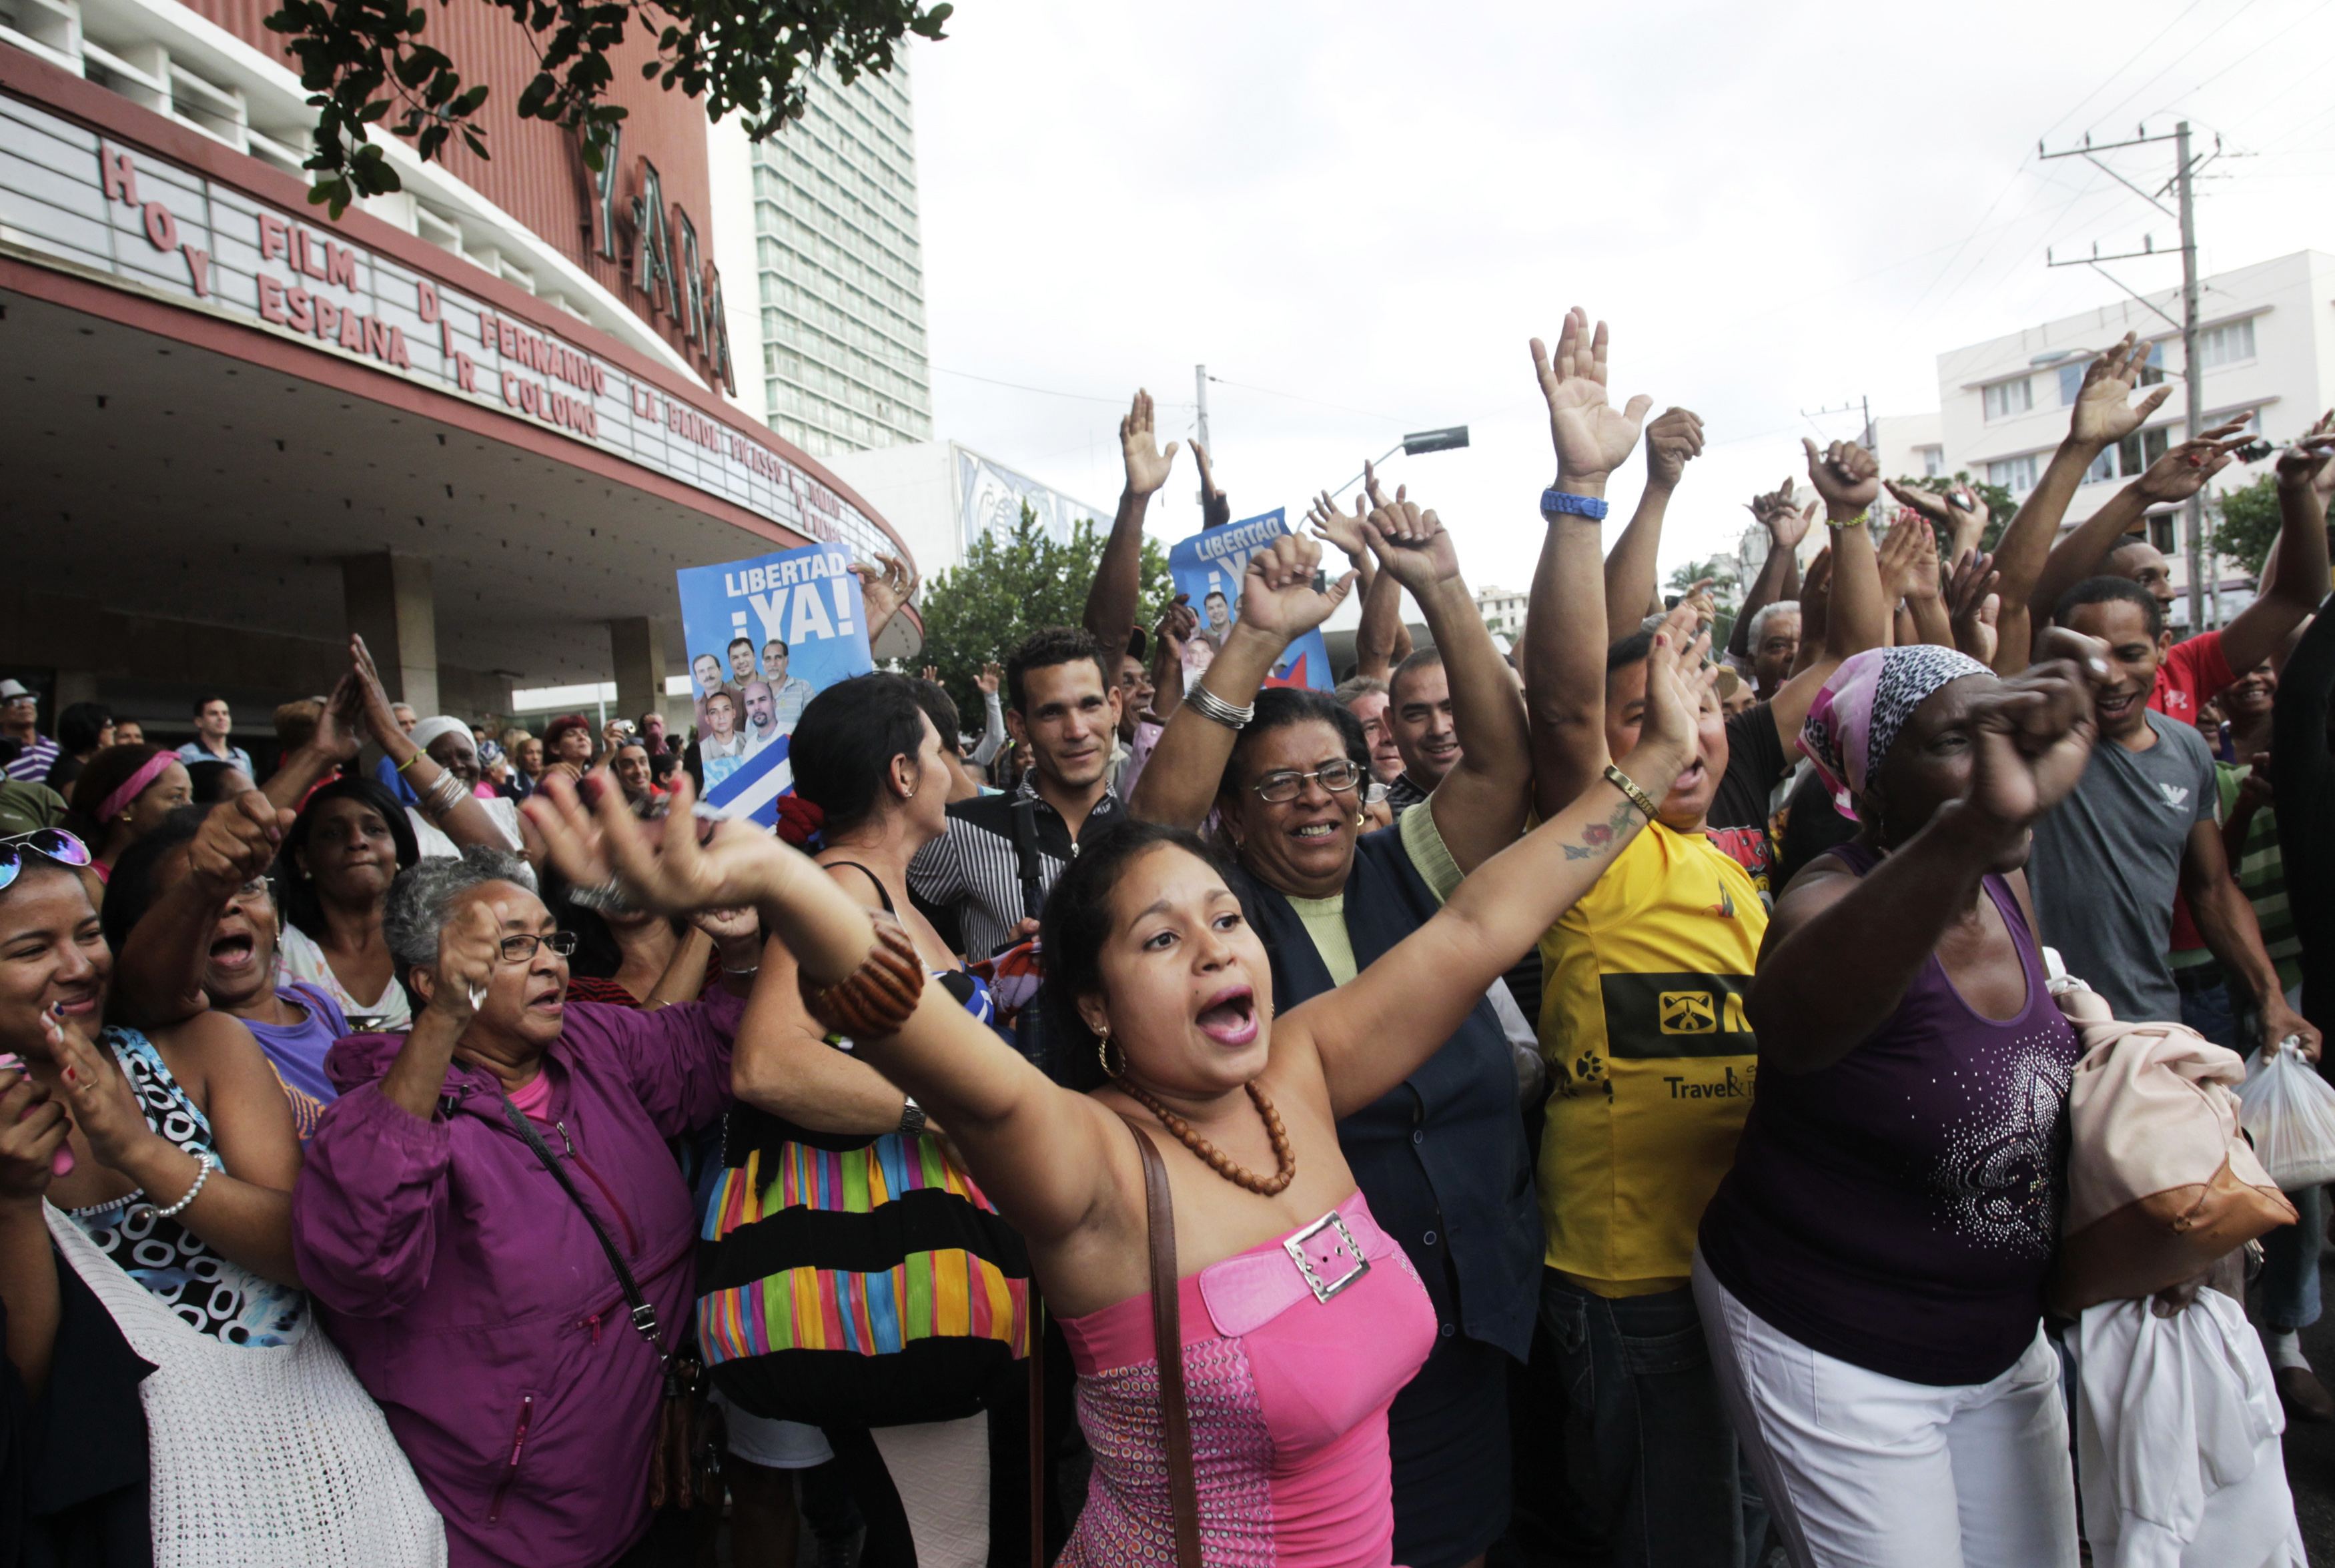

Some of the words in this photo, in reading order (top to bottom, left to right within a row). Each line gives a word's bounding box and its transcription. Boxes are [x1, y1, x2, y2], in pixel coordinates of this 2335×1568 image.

[100, 141, 210, 297] HOY
[258, 212, 359, 293] FILM
[418, 280, 478, 394] DIR
[479, 311, 606, 398] FERNANDO
[502, 369, 598, 440] COLOMO
[632, 383, 660, 424] LA
[667, 401, 722, 455] BANDA
[731, 434, 783, 486] PICASSO
[725, 552, 847, 598] LIBERTAD
[1194, 516, 1282, 562] LIBERTAD
[731, 578, 855, 646] ¡YA!
[1663, 1066, 1735, 1099] Travel
